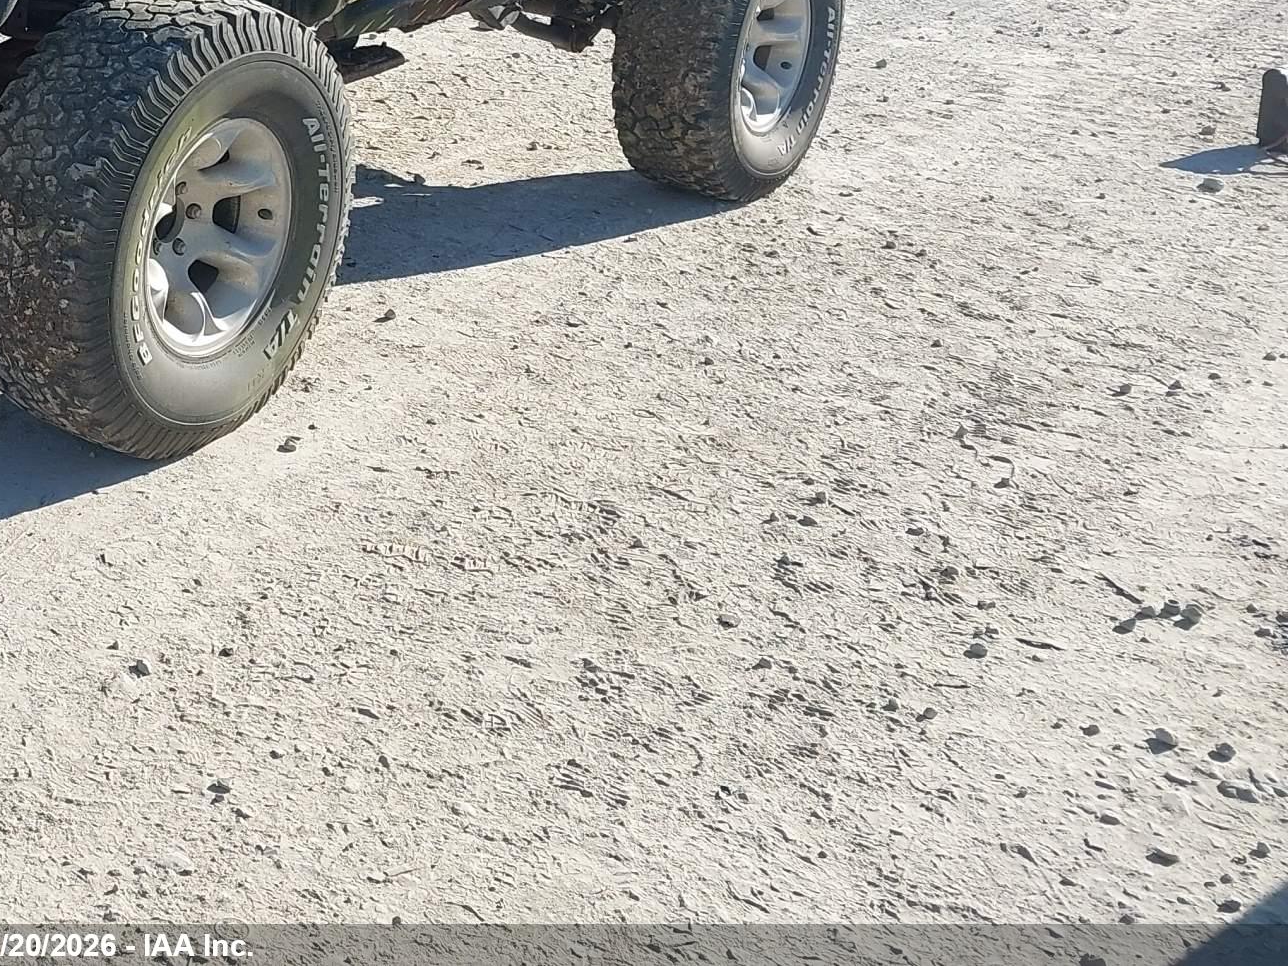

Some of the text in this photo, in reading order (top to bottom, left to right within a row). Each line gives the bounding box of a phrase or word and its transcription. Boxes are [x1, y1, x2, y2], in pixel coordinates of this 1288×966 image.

[796, 6, 836, 135] All-Terrain
[131, 126, 193, 366] BFGoodrich
[297, 117, 331, 304] All-Terrain
[263, 309, 300, 360] T/A
